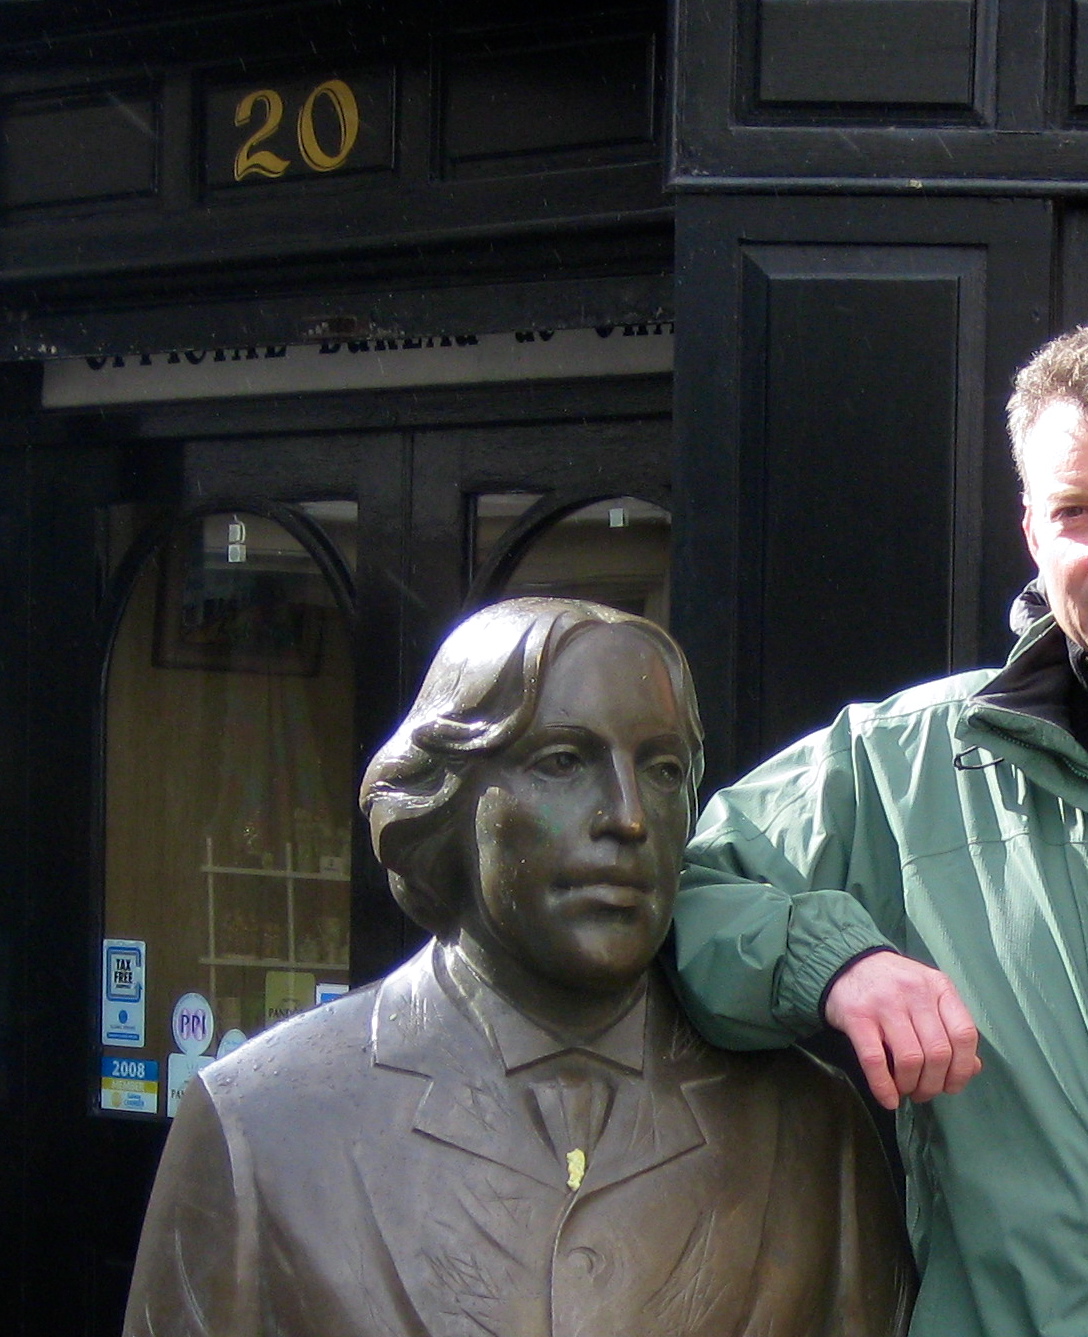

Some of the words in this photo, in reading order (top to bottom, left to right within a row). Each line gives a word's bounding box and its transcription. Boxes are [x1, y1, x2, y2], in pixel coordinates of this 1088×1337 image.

[234, 79, 359, 182] 20
[116, 958, 132, 971] TAX
[114, 971, 133, 984] FREE
[181, 1014, 206, 1036] PPI
[112, 1060, 146, 1079] 2008
